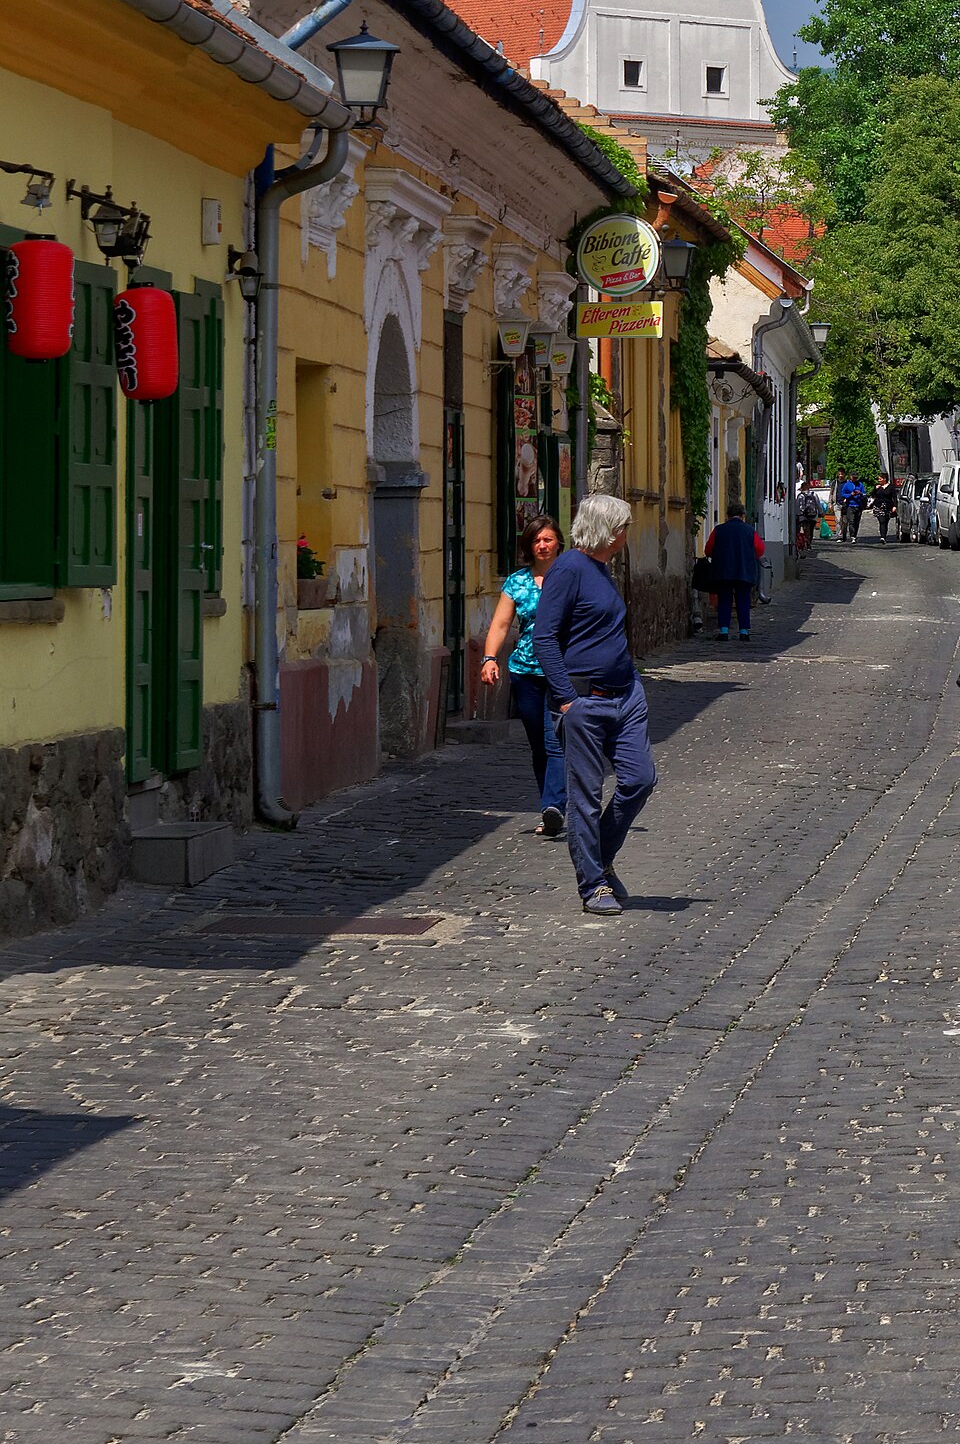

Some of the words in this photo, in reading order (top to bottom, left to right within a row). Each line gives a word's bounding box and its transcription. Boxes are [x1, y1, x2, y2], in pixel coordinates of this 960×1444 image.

[583, 231, 641, 255] Bibione
[611, 243, 652, 267] Caffé
[605, 275, 622, 285] Pizza
[623, 273, 629, 281] &
[629, 271, 641, 280] Bar
[580, 305, 632, 325] Étterem
[608, 315, 661, 335] Pizzéria
